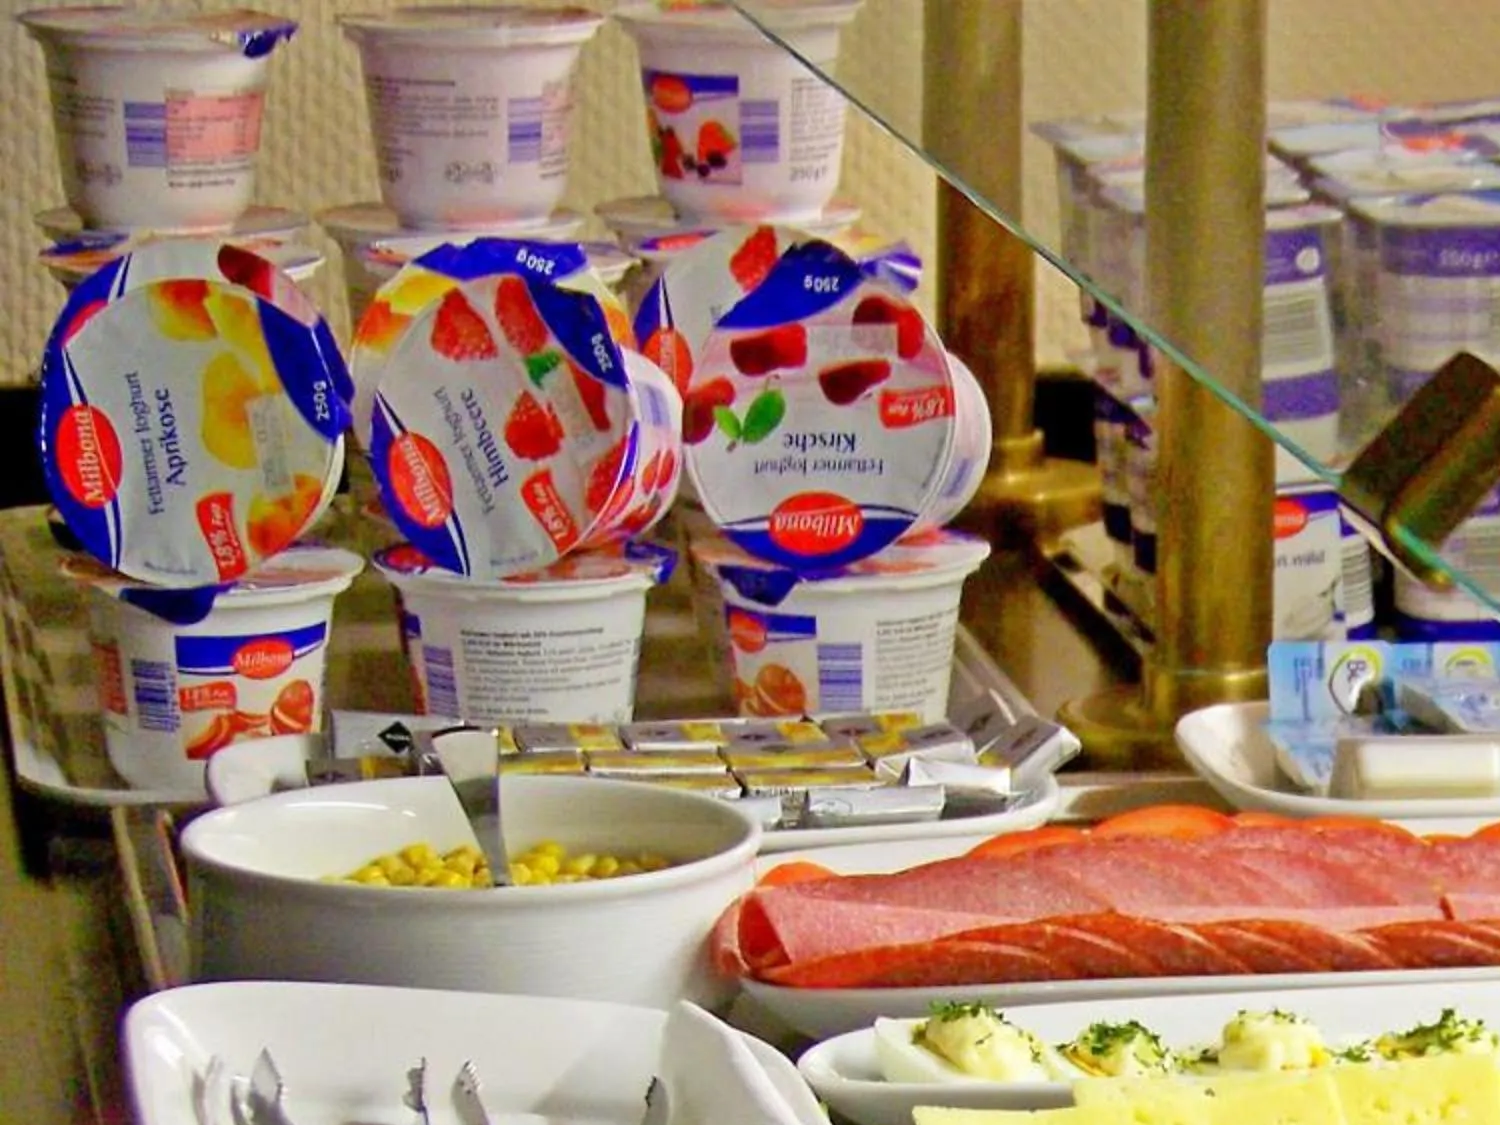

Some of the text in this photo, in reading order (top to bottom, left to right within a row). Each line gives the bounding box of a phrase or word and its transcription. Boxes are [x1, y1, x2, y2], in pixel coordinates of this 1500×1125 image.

[515, 247, 556, 275] 250g
[803, 274, 840, 292] 250g
[313, 380, 329, 421] 250g
[155, 388, 188, 486] Aprikose
[459, 387, 510, 488] Himbeere
[782, 432, 857, 452] Kirsche
[72, 409, 103, 503] Milbona
[811, 458, 884, 476] Fettarmer
[399, 437, 443, 520] Milbona
[773, 512, 860, 538] Milbona
